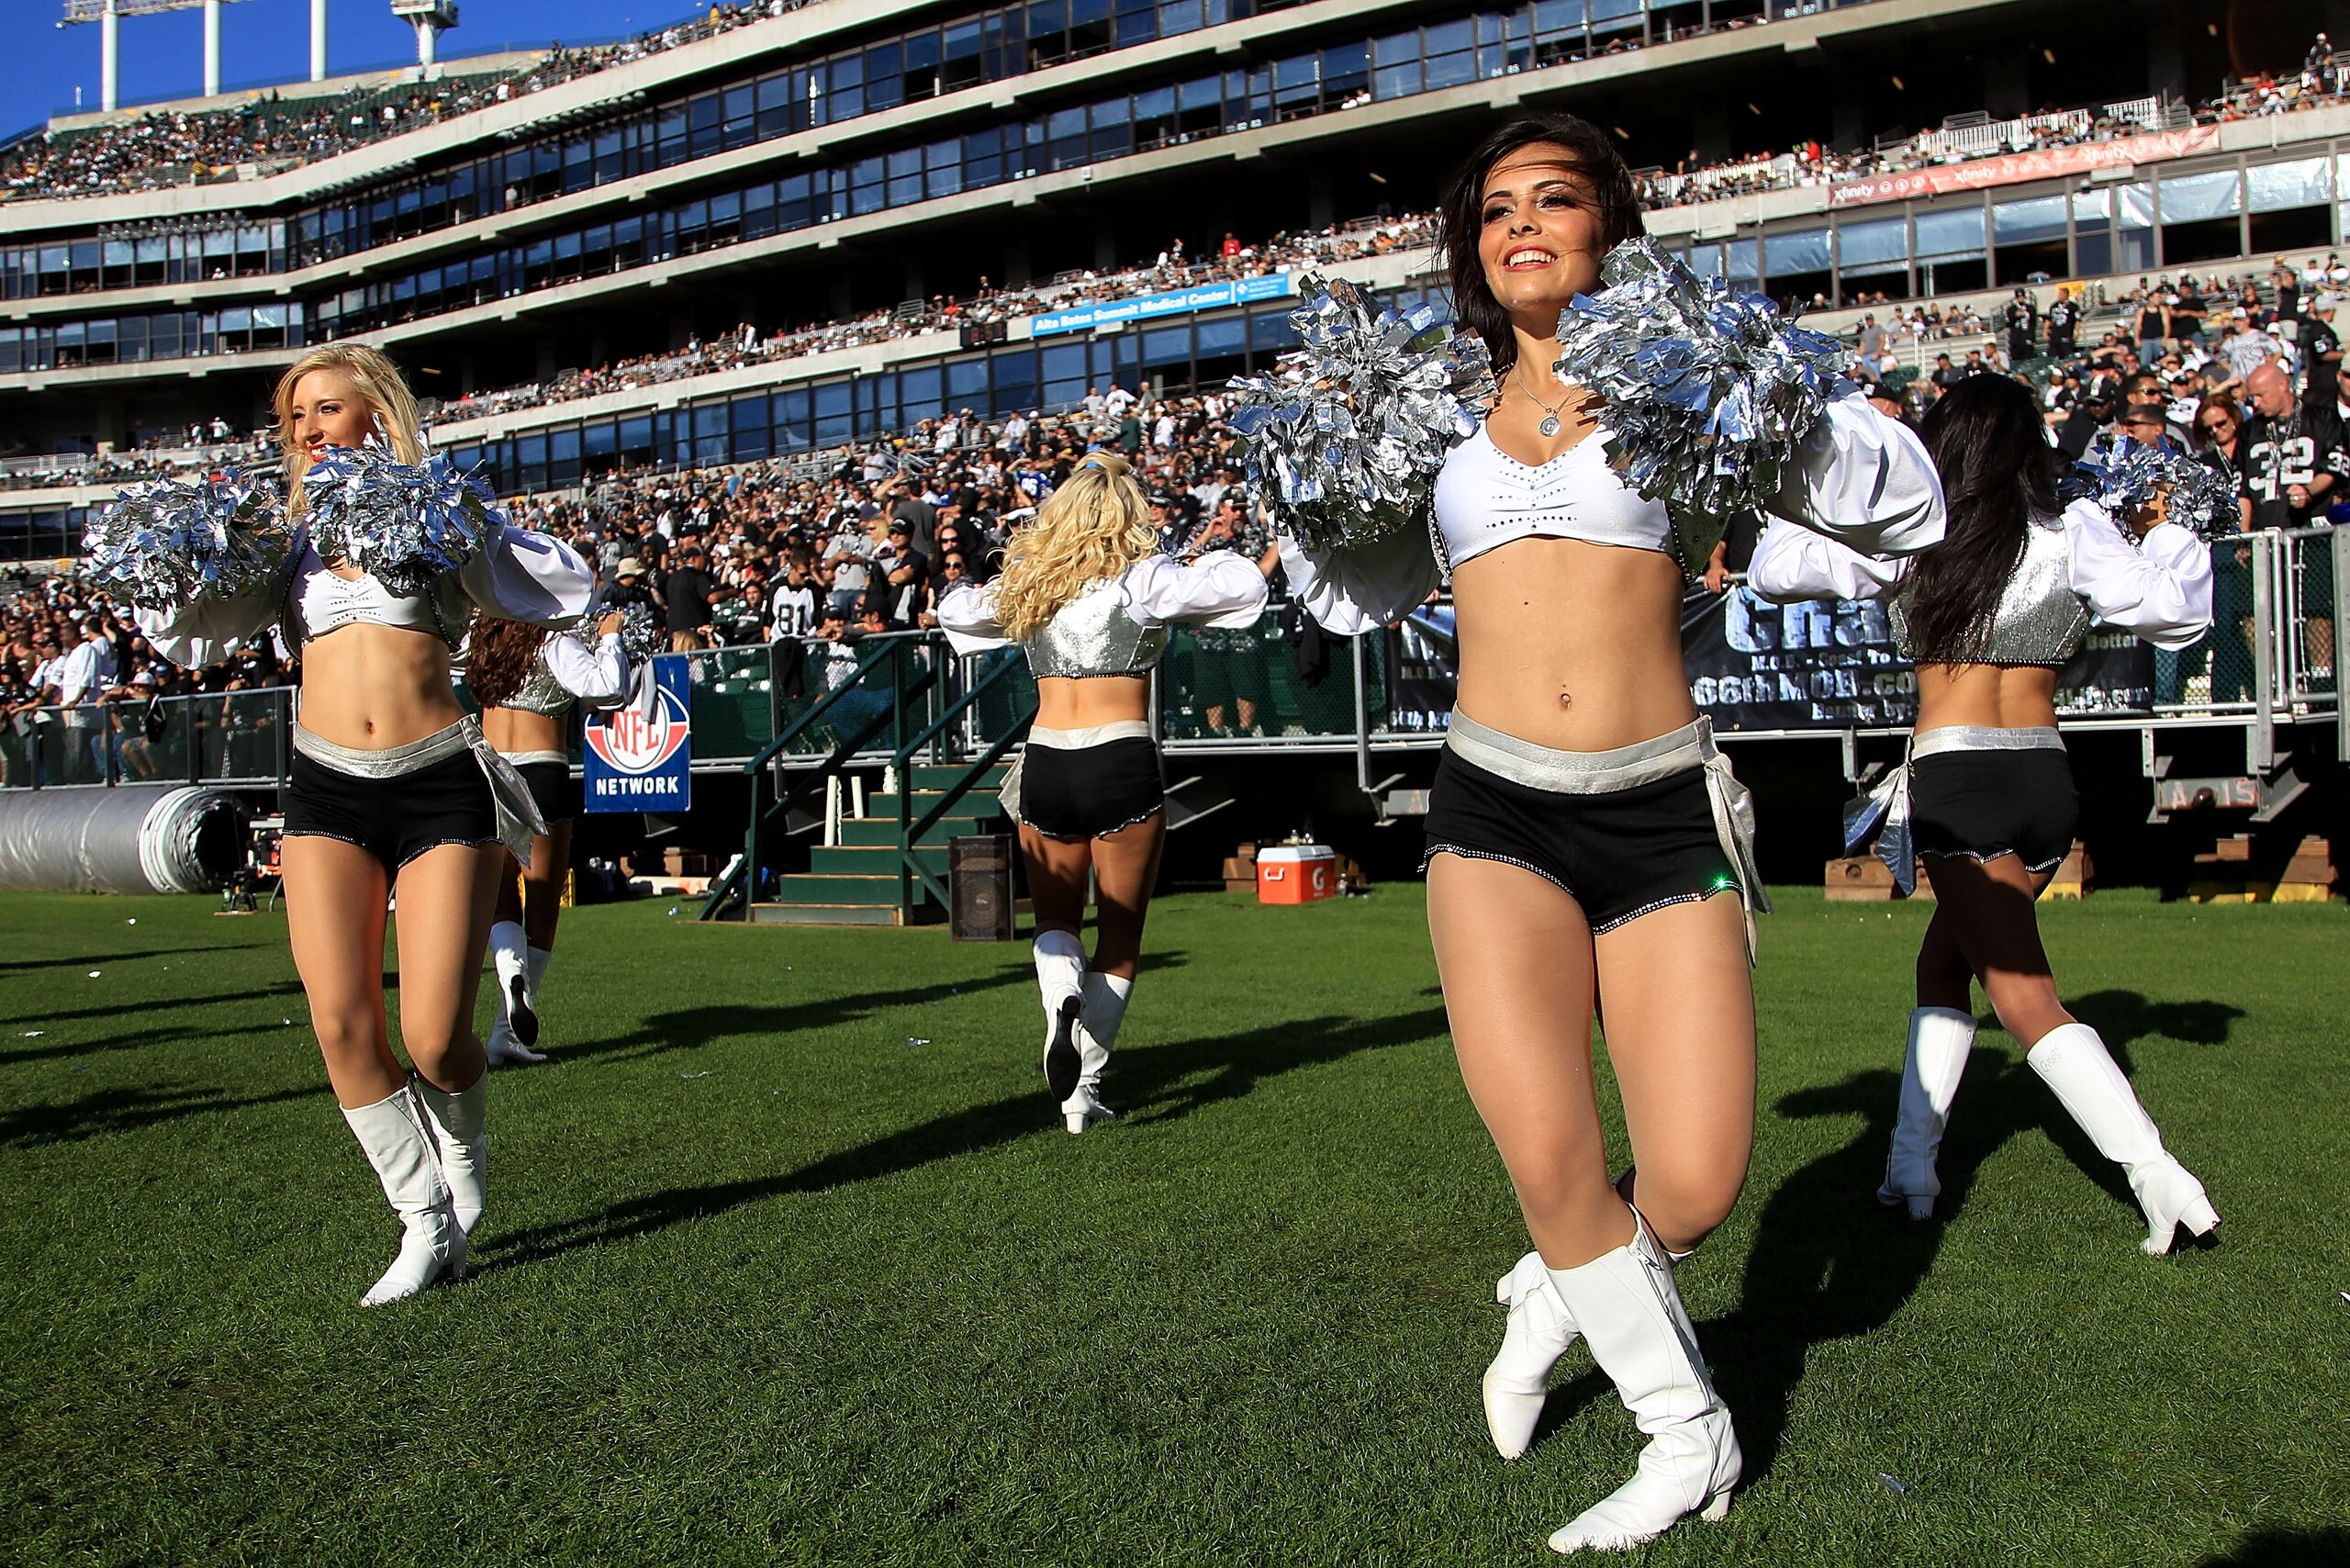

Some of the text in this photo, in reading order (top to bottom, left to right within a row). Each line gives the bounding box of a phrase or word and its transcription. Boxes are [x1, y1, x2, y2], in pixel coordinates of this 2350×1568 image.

[1035, 291, 1230, 331] Alta Bates Summit Medical Center
[2249, 436, 2314, 491] 32
[778, 604, 807, 635] 81
[613, 711, 659, 756] NFL
[597, 777, 678, 796] NETWORK
[1313, 867, 1325, 891] G
